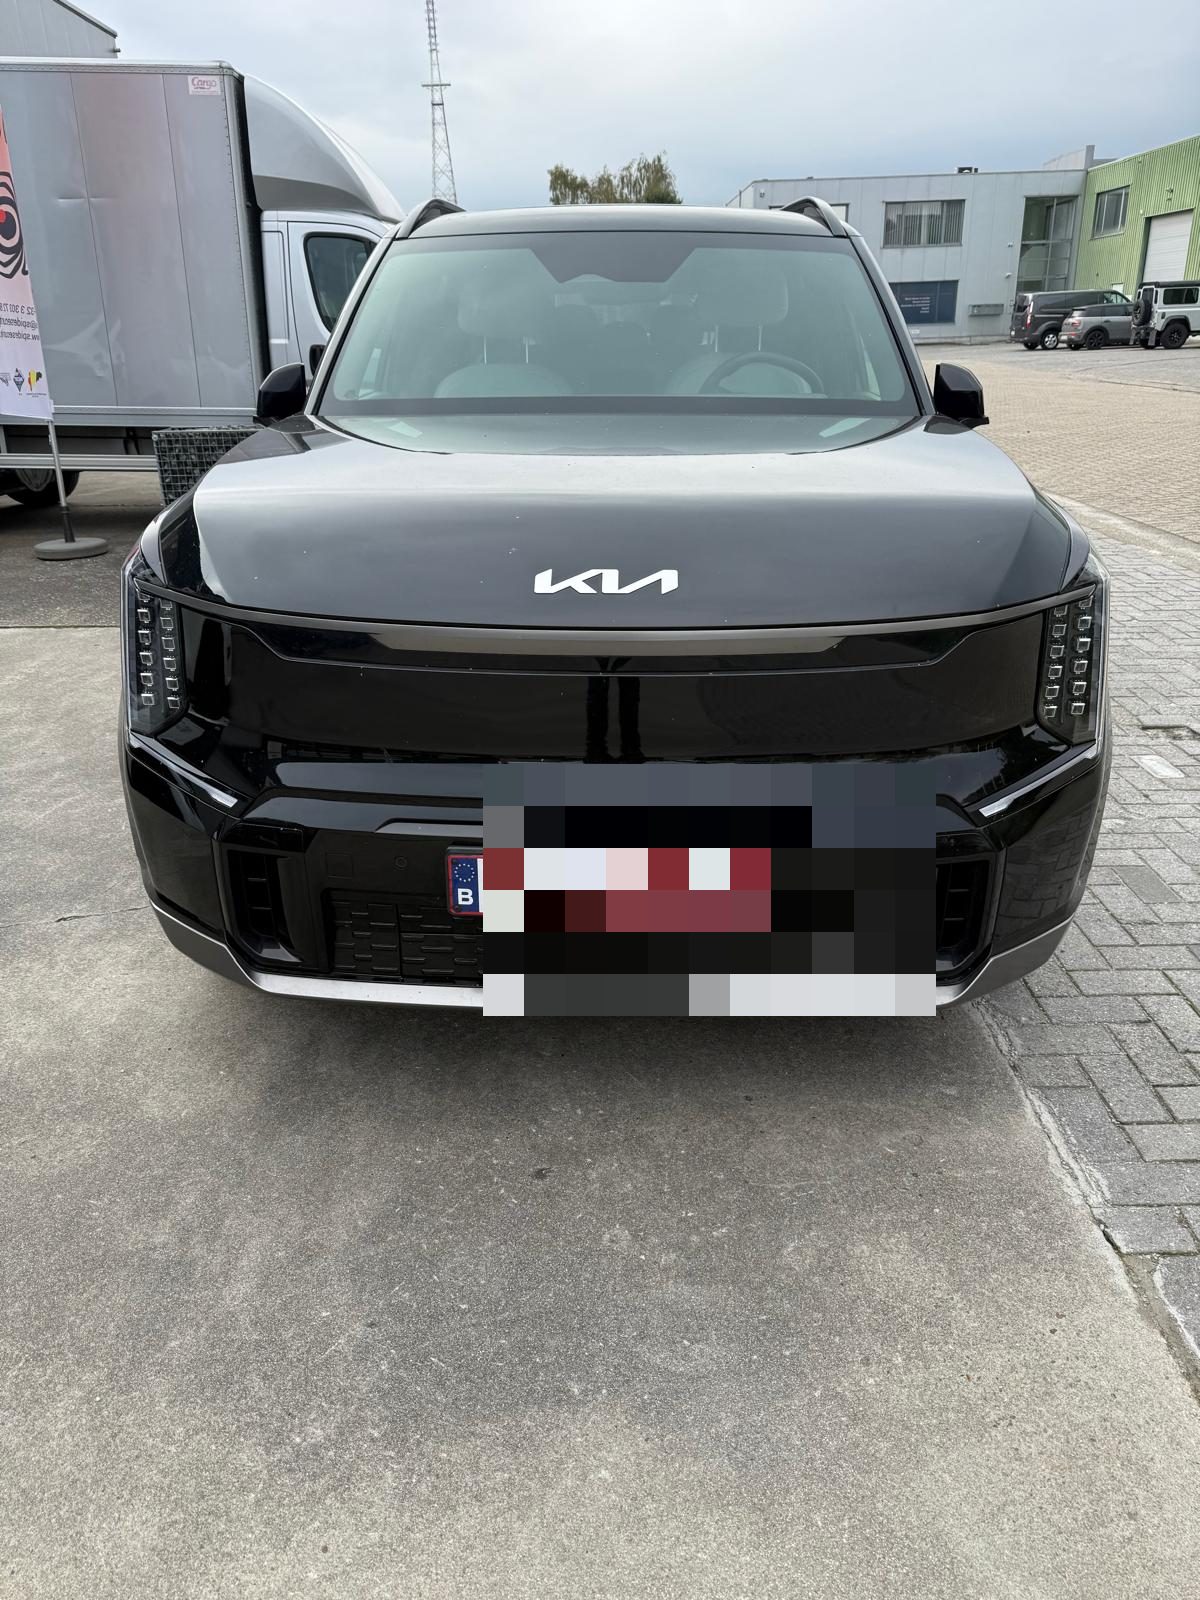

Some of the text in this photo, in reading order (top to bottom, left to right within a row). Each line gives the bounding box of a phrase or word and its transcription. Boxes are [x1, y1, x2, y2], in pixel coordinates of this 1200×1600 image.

[192, 77, 217, 88] Cargo
[533, 568, 679, 595] KIA
[457, 888, 474, 905] B
